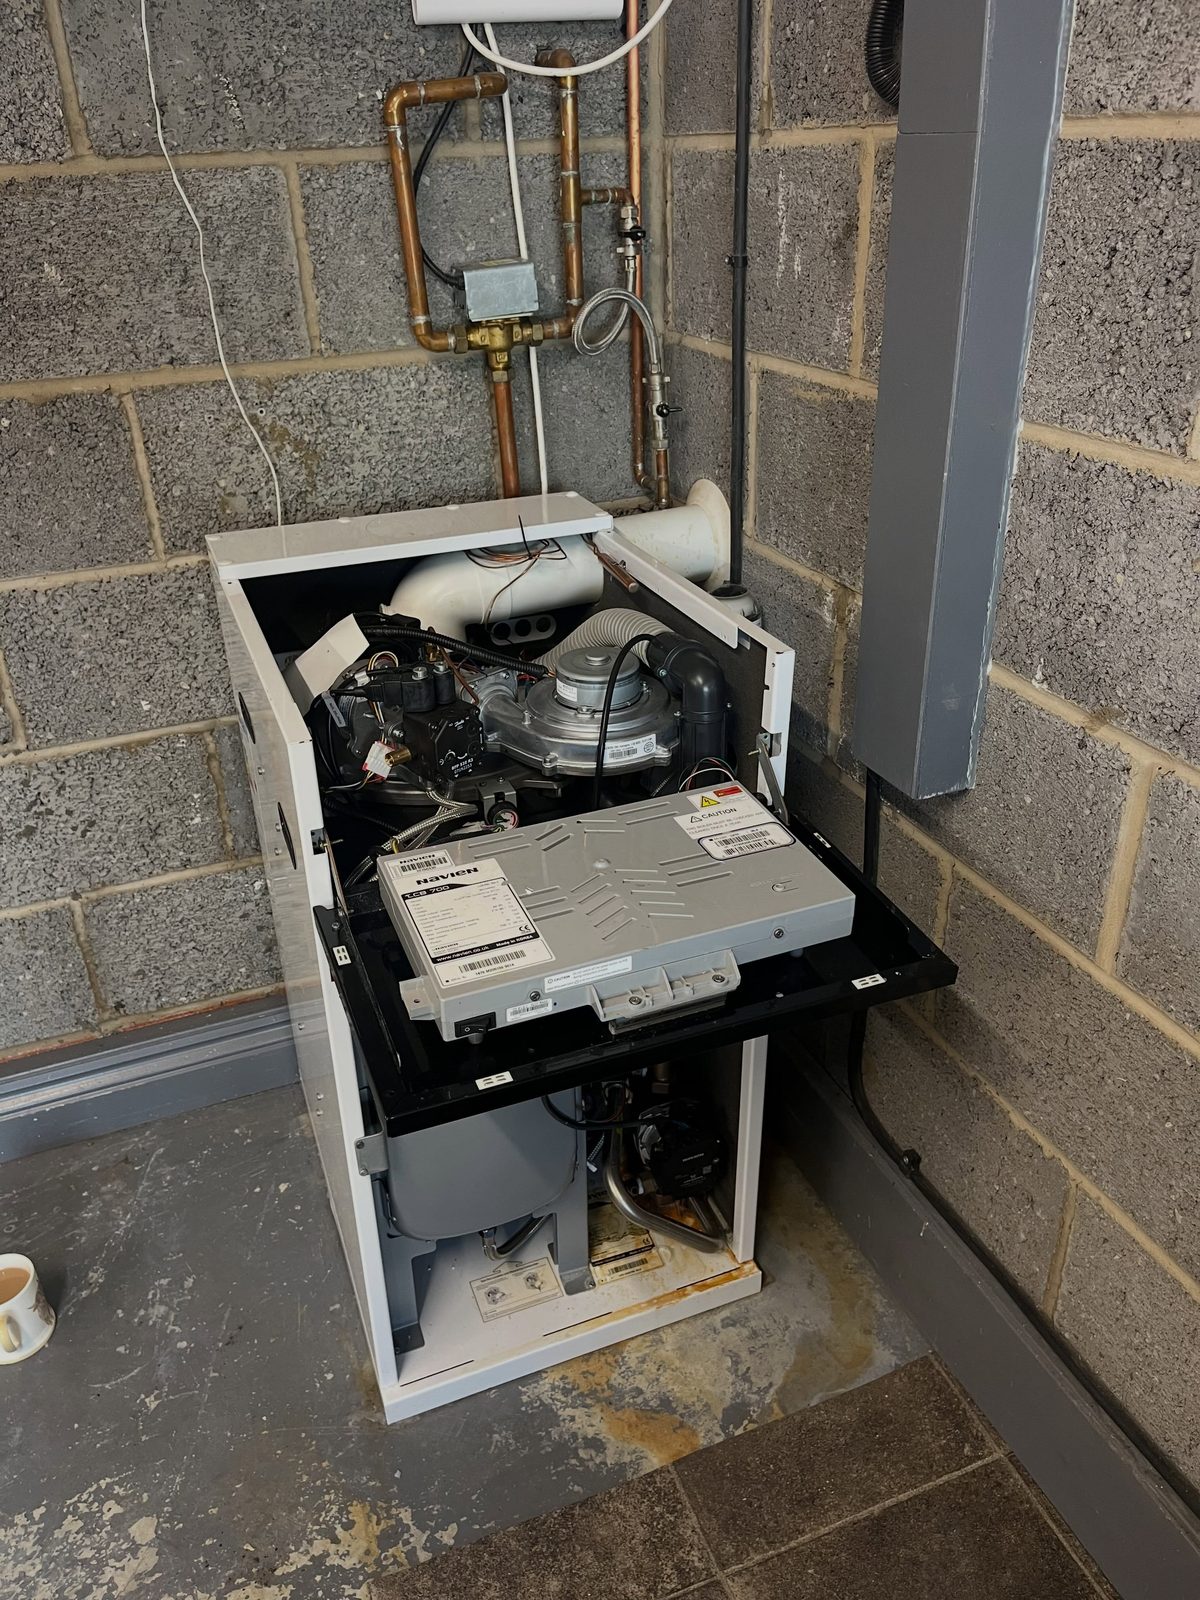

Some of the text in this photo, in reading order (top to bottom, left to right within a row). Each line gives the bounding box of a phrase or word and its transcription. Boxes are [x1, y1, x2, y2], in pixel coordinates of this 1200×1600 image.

[702, 807, 738, 819] CAUTION
[430, 885, 450, 893] 700
[437, 946, 490, 962] www.navien.co.uk
